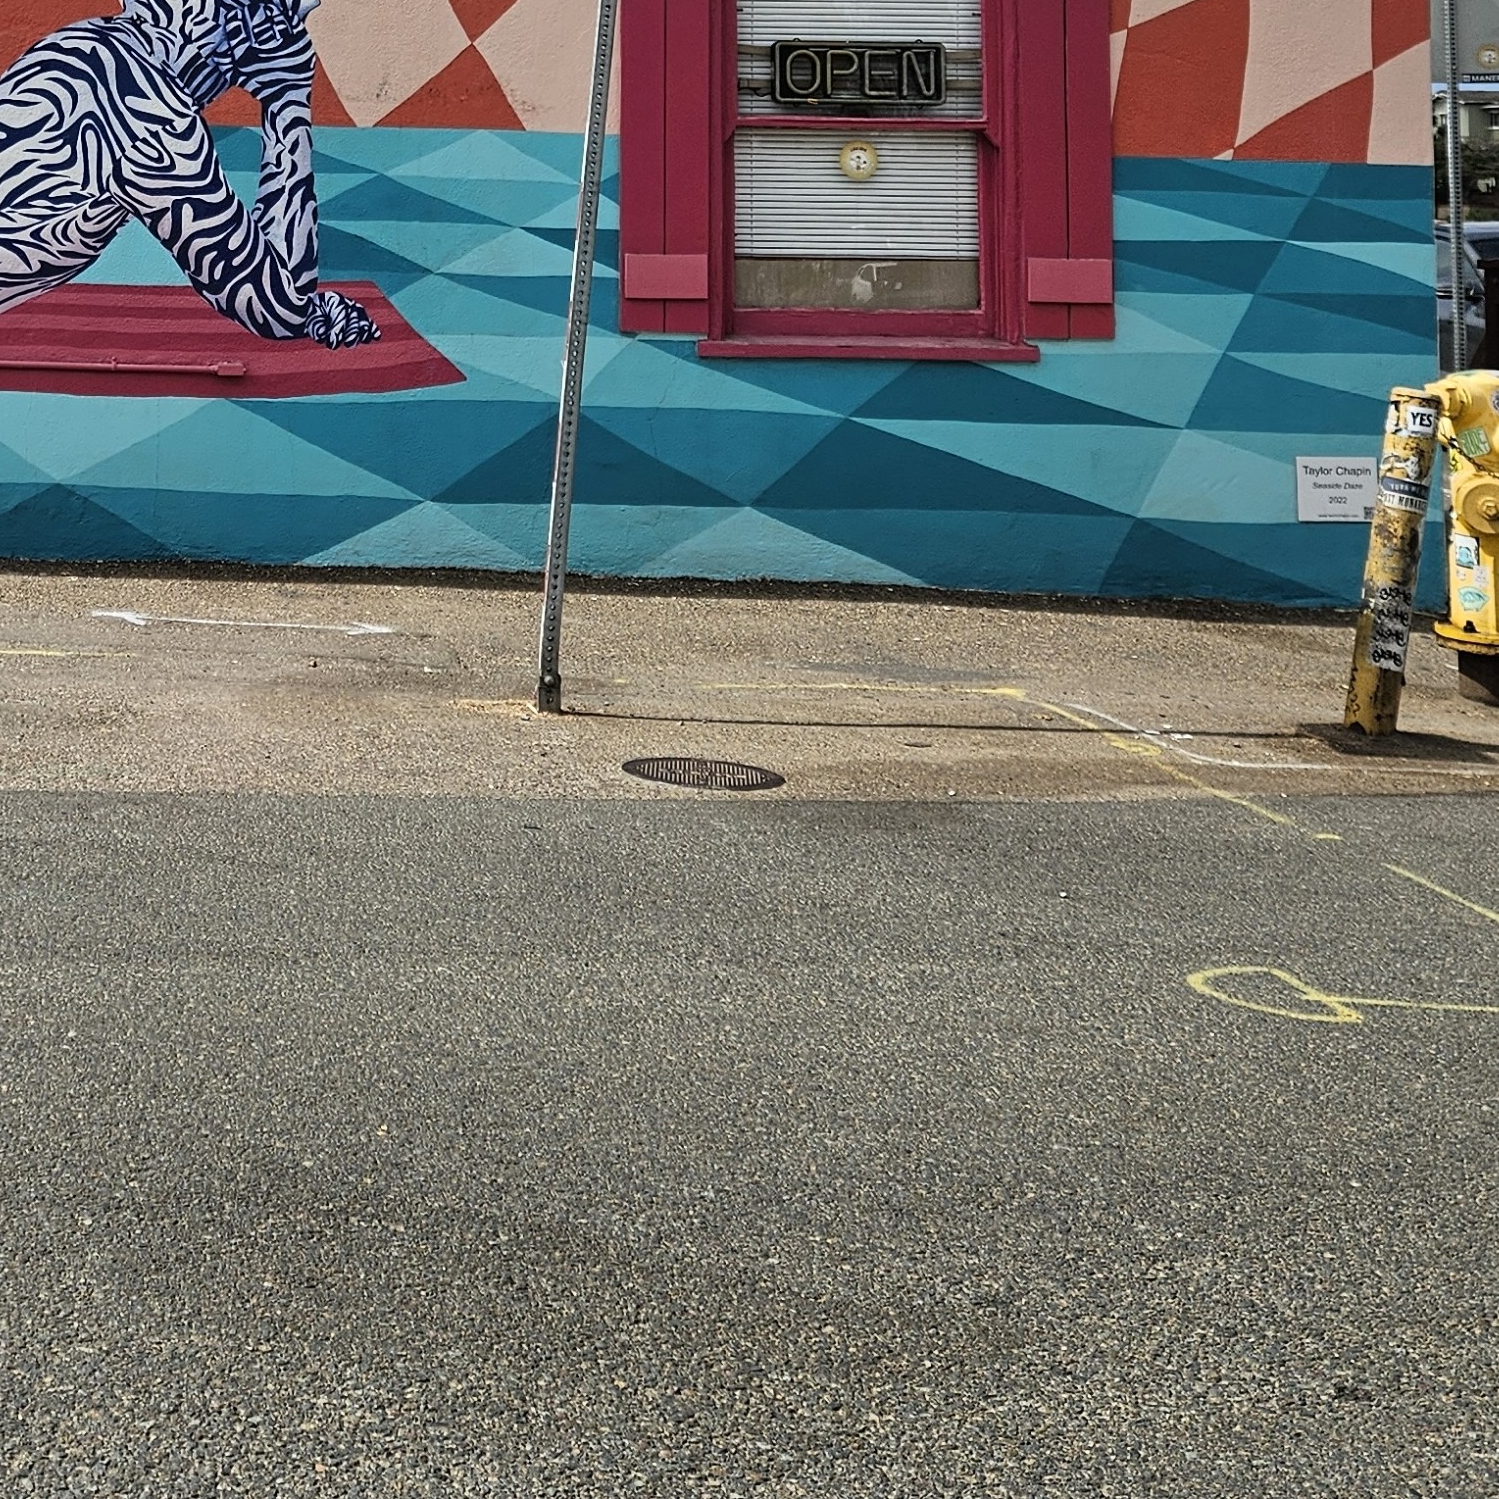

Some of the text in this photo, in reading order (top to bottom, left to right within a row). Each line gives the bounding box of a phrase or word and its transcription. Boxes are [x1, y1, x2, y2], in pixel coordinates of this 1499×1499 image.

[786, 49, 935, 97] OPEN
[1411, 412, 1433, 428] YES
[1303, 465, 1372, 478] Taylor Chapin
[1313, 482, 1363, 490] Seaside Daze
[1329, 496, 1348, 504] 2022
